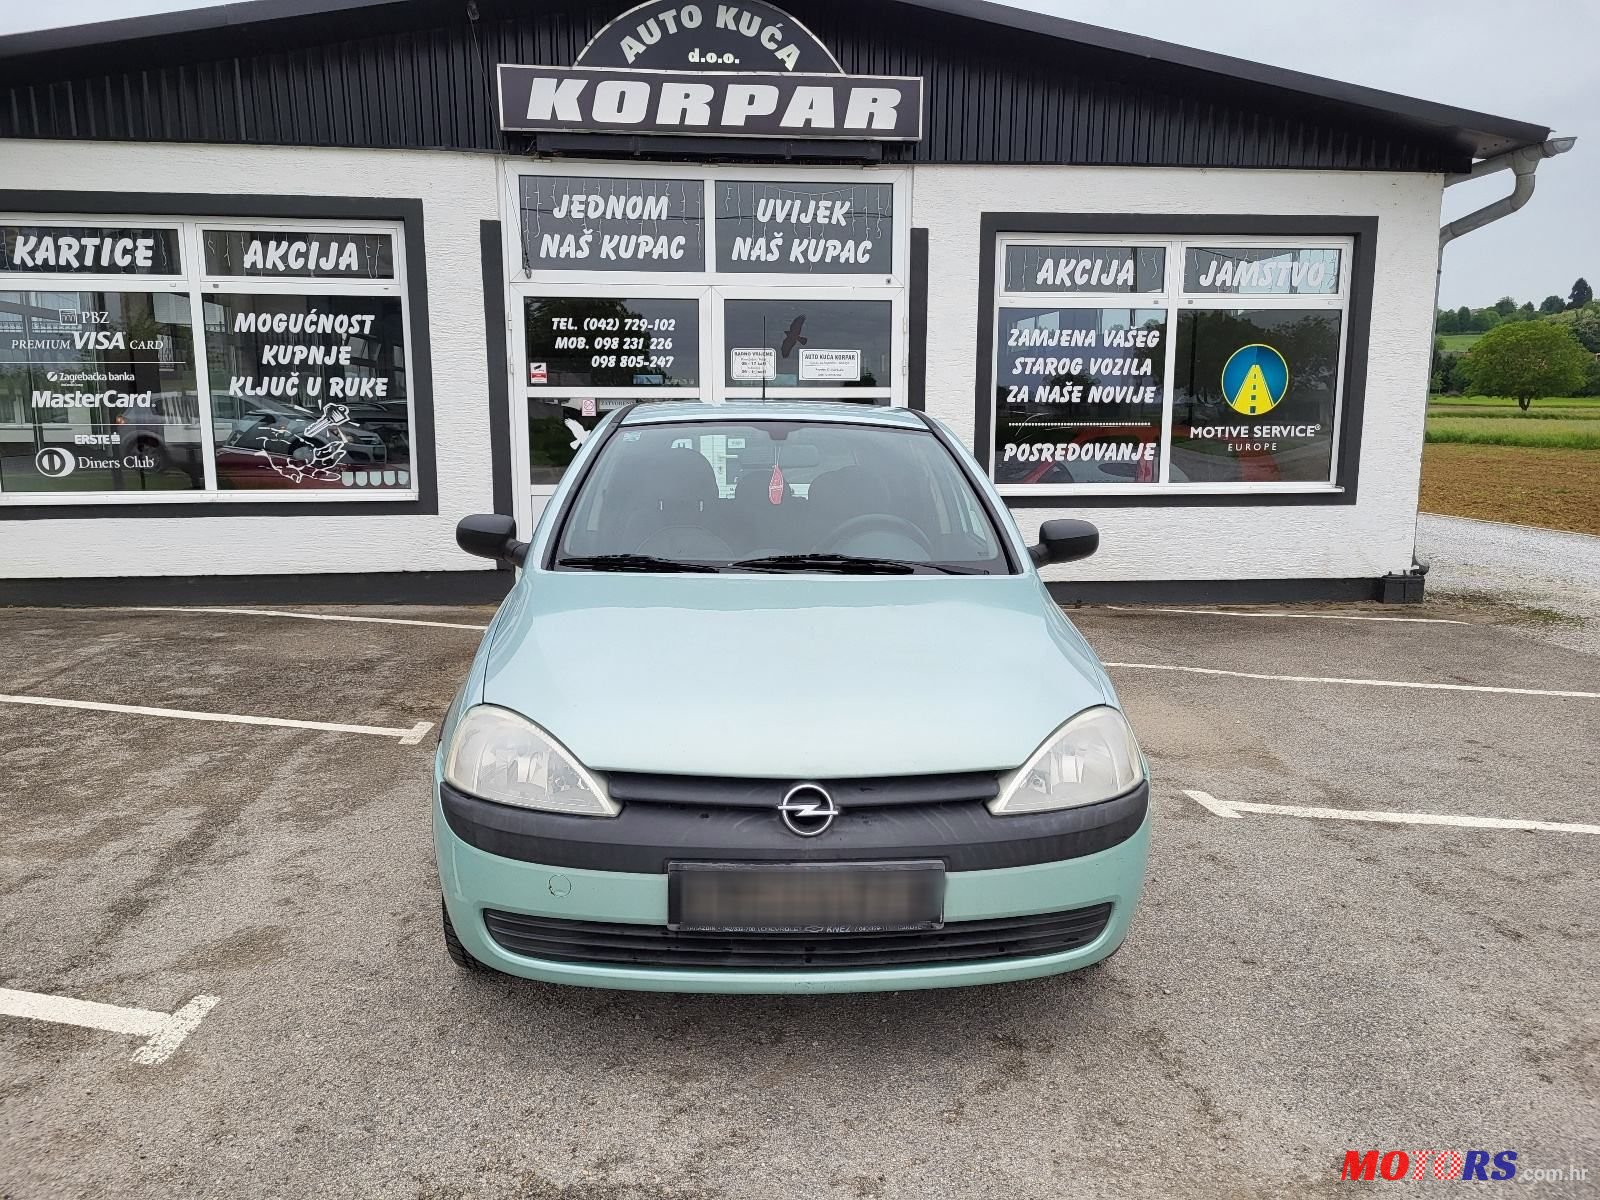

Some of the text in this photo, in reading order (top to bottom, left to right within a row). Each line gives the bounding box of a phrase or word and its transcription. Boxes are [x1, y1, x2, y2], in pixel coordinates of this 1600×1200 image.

[619, 4, 801, 71] AUTO KUĆA
[688, 48, 740, 64] d.o.o.
[527, 77, 902, 130] KORPAR
[553, 194, 668, 220] JEDNOM
[757, 198, 851, 226] UVIJEK
[12, 235, 154, 267] KARTICE
[243, 240, 359, 271] AKCIJA
[540, 229, 686, 260] NAŠ KUPAC
[732, 232, 873, 264] NAŠ KUPAC
[1036, 258, 1134, 286] AKCIJA
[1199, 260, 1325, 287] JAMSTVO
[82, 311, 109, 324] PBZ
[233, 309, 374, 335] MOGUĆNOST
[552, 317, 676, 333] TEL. (042) 729-102
[11, 331, 164, 350] PREMIUM VISA CARD
[555, 336, 673, 350] MOB. 098 231 226
[1008, 326, 1160, 348] ZAMJENA VAŠEG
[262, 344, 351, 367] KUPNJE
[591, 355, 675, 369] 098 805-247
[1012, 357, 1152, 376] STAROG VOZILA
[109, 371, 135, 382] banka
[229, 371, 389, 398] KLJUČ U RUKE
[1006, 381, 1155, 404] ZA NAŠE NOVIJE
[74, 434, 110, 445] ERSTE
[1190, 426, 1248, 439] MOTIVE
[1004, 442, 1157, 462] POSREDOVANJE
[1227, 442, 1278, 452] EUROPE
[79, 456, 154, 469] Diners Club
